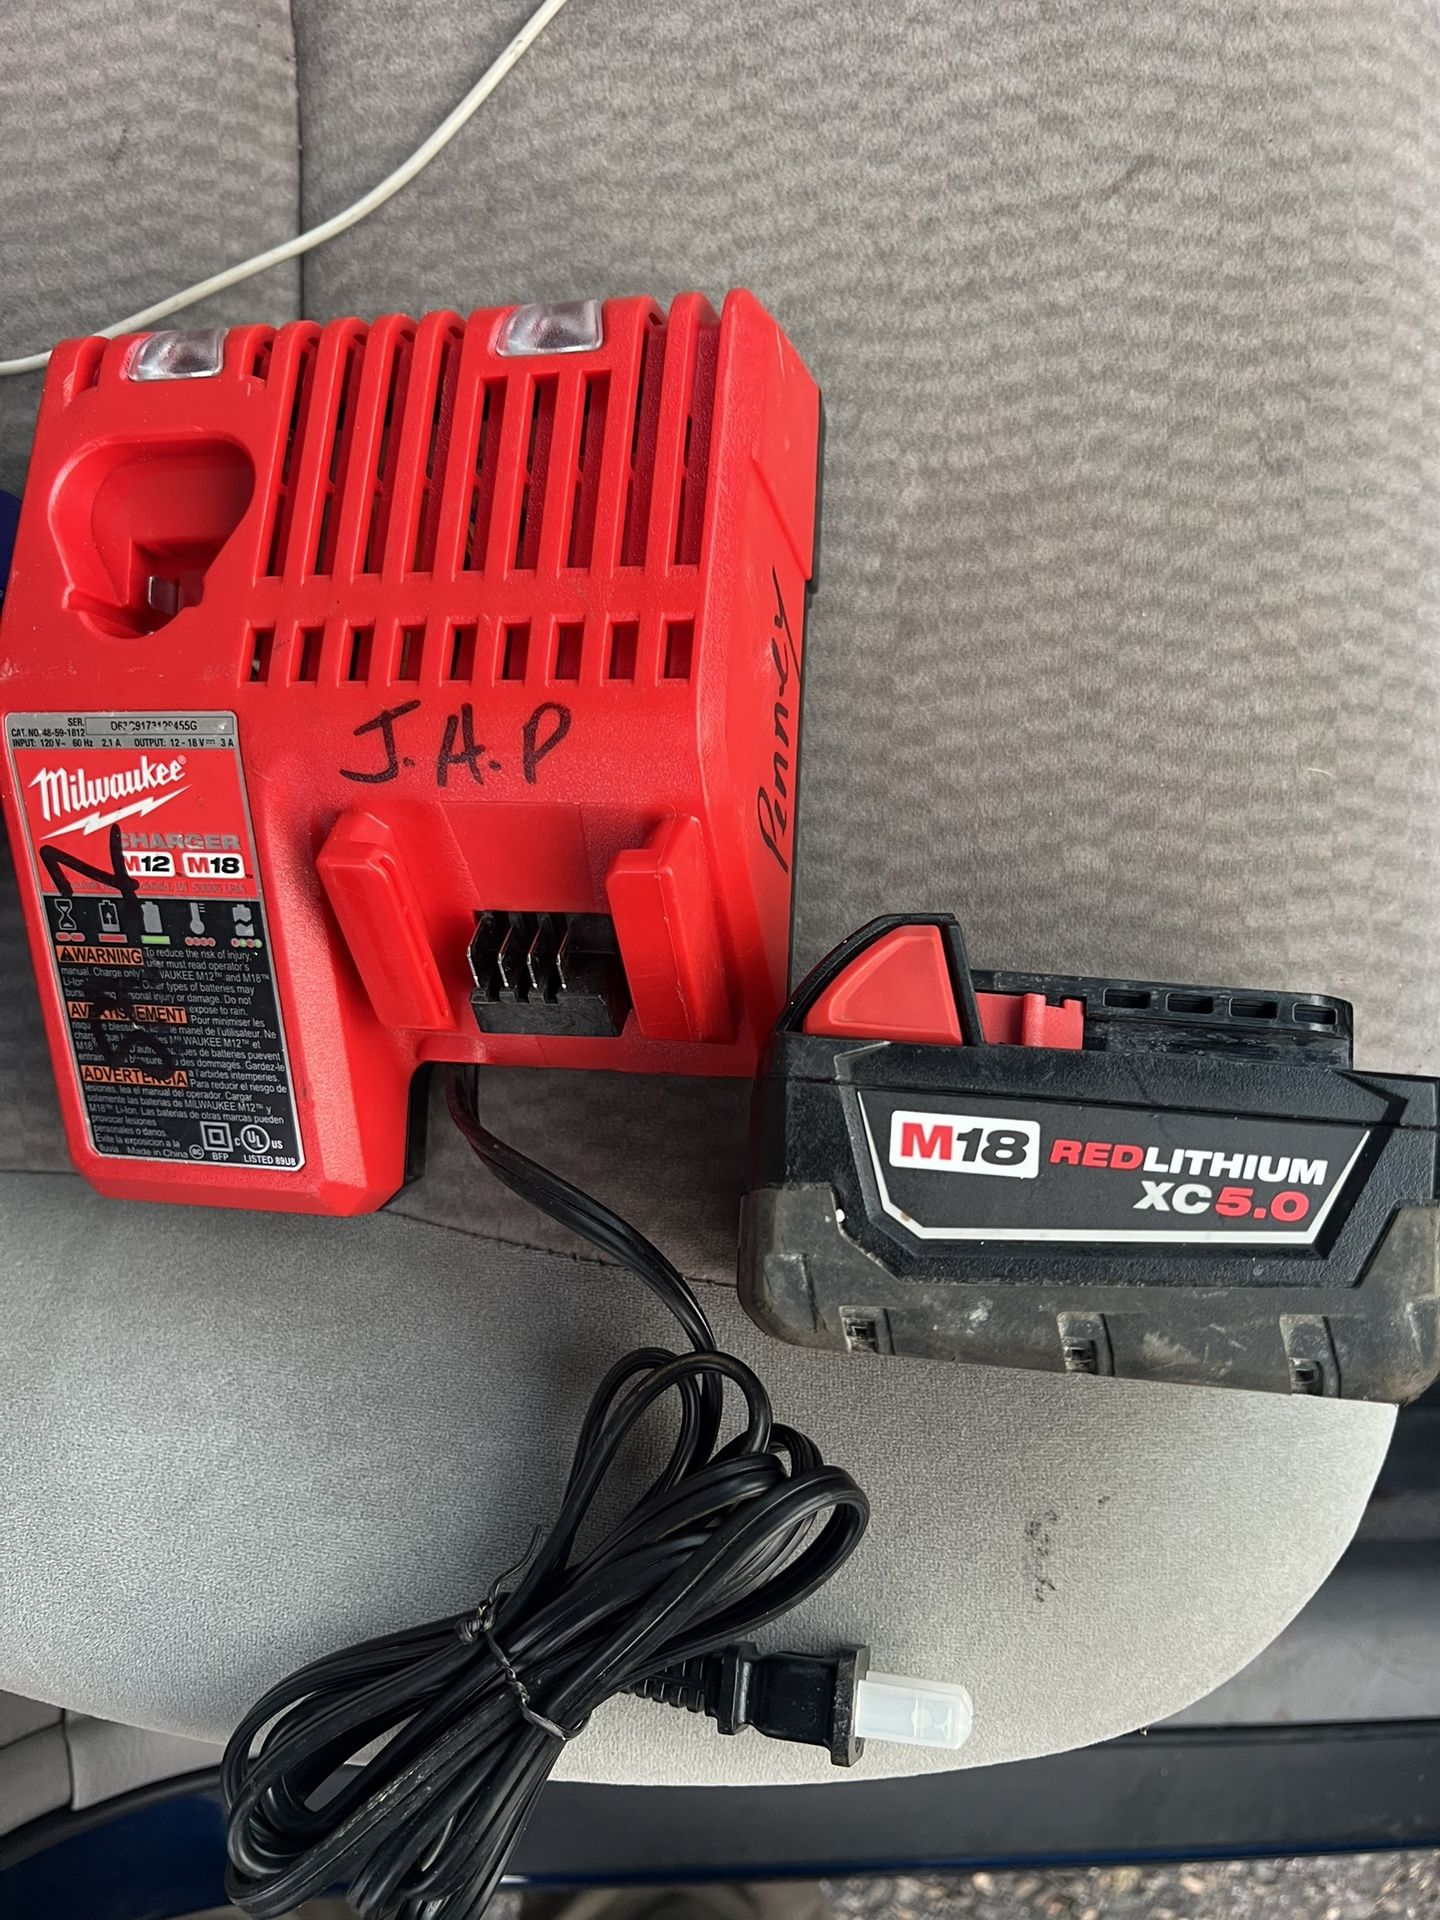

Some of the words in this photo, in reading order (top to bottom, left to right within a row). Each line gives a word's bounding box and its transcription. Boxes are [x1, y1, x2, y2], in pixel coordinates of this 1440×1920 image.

[12, 729, 26, 737] CAT.
[29, 729, 41, 737] NO.
[43, 729, 85, 737] 48-59-1812
[13, 739, 36, 747] INPUT:
[41, 739, 54, 747] 120
[73, 739, 82, 747] 60
[84, 739, 93, 747] Hz
[102, 739, 113, 747] 2.1
[116, 739, 122, 747] A
[134, 739, 166, 747] OUTPUT:
[171, 739, 180, 747] 12
[189, 739, 198, 747] 18
[221, 739, 226, 747] 3
[228, 739, 234, 747] A
[73, 948, 143, 964] WARNING
[144, 947, 155, 957] To
[157, 948, 185, 958] reduce
[186, 949, 199, 959] the
[201, 950, 216, 959] risk
[217, 950, 225, 959] of
[227, 952, 252, 962] injury,
[166, 960, 187, 969] must
[188, 961, 207, 969] read
[209, 962, 250, 972] operator's
[93, 967, 122, 978] Charge
[124, 969, 140, 980] only
[225, 974, 241, 982] and
[142, 980, 164, 990] Oer
[167, 981, 188, 993] types
[190, 982, 198, 992] of
[201, 983, 235, 993] batteries
[237, 986, 255, 995] may
[153, 992, 176, 1004] injury
[177, 994, 185, 1002] or
[187, 994, 222, 1006] damage.
[224, 995, 236, 1005] Do
[238, 996, 252, 1005] not
[189, 1006, 219, 1015] expose
[220, 1006, 228, 1015] to
[230, 1008, 248, 1016] rain.
[169, 1036, 222, 1048] MWAUKEE
[212, 1152, 229, 1161] BFP
[244, 1154, 274, 1165] LISTED
[901, 1122, 1030, 1166] M18
[1050, 1138, 1328, 1186] REDLITHIUM
